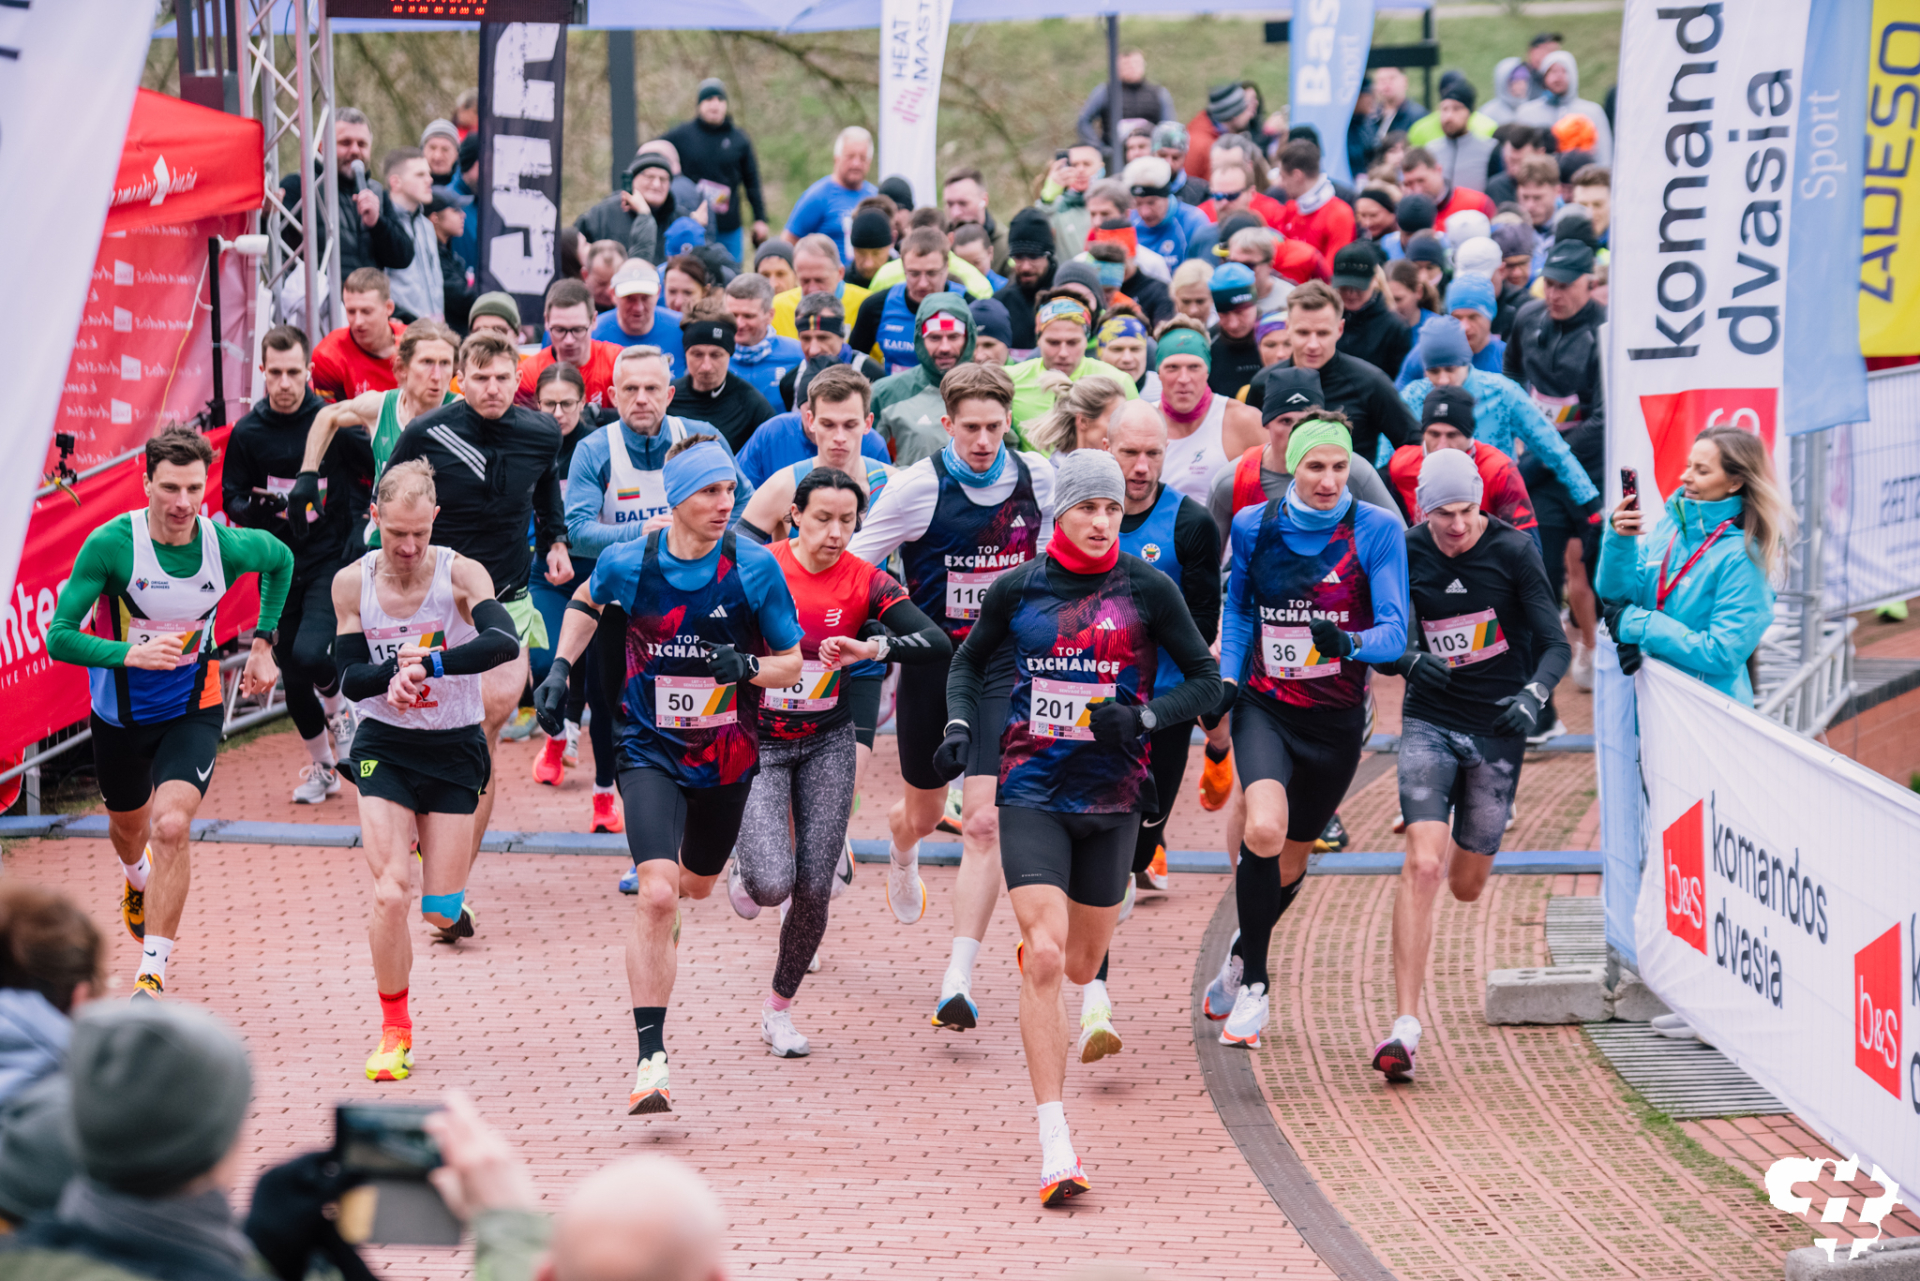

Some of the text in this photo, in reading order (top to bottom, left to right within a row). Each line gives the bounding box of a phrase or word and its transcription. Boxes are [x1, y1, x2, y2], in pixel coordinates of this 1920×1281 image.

[892, 16, 910, 79] HEAT
[1800, 89, 1848, 200] Sport
[1627, 2, 1724, 361] komand
[1717, 68, 1793, 355] dvasia
[978, 545, 1000, 554] TOP
[945, 551, 1026, 567] EXCHANGE
[1288, 600, 1313, 608] TOP
[1260, 605, 1350, 623] EXCHANGE
[676, 635, 700, 644] TOP
[1432, 633, 1468, 652] 103
[374, 643, 405, 660] 15
[1057, 647, 1083, 656] TOP
[1272, 644, 1296, 662] 36
[1026, 658, 1120, 674] EXCHANGE
[668, 694, 694, 711] 50
[1036, 698, 1073, 720] 201
[1711, 790, 1828, 945] komandos
[1714, 897, 1783, 1010] dvasia
